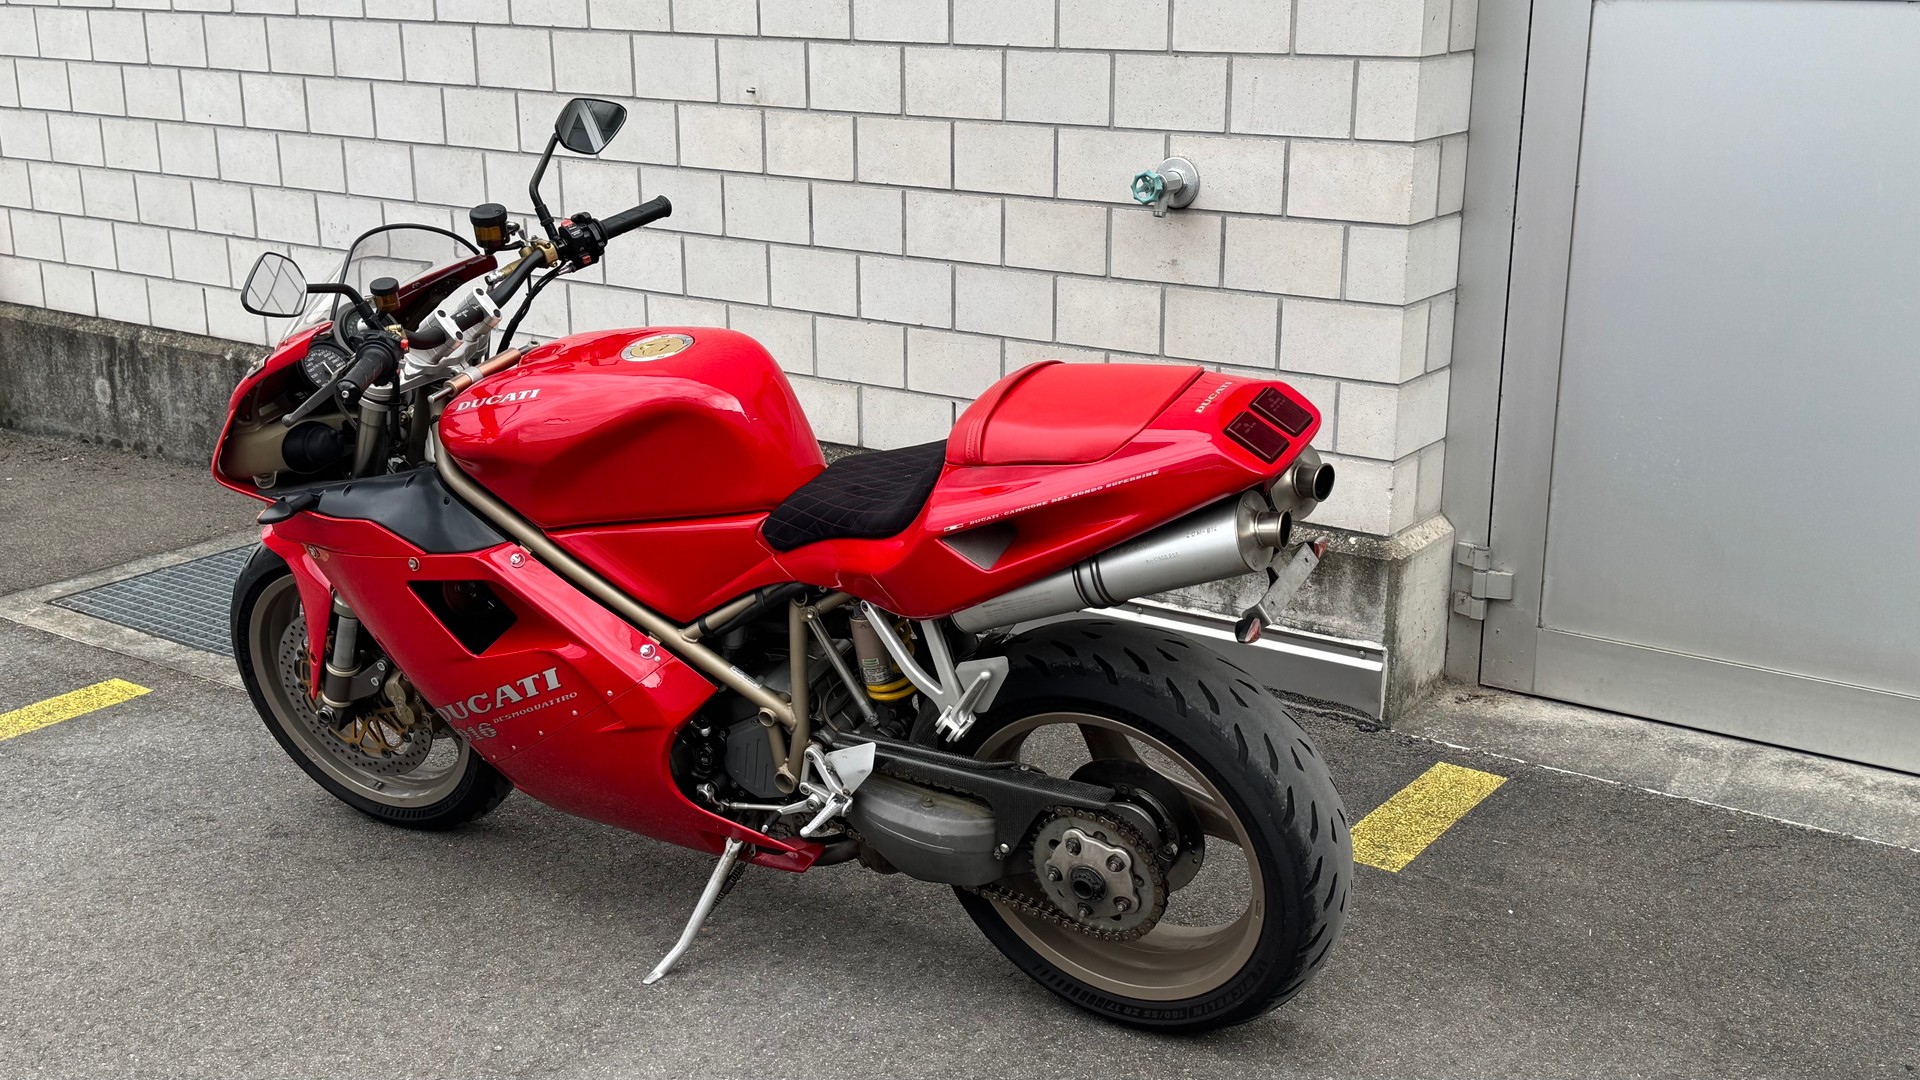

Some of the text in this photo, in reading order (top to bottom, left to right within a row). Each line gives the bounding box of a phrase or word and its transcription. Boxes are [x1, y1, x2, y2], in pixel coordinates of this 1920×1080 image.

[455, 388, 541, 412] DUCATI
[1194, 381, 1234, 414] DUCATI
[969, 469, 1160, 526] DUCATI CAMPIONE DEL MONDO SUPERBIKE
[492, 691, 578, 724] DESMOQUATTRO
[1106, 1001, 1121, 1013] 17
[1123, 1005, 1141, 1017] ZR
[1193, 975, 1255, 1018] MICHELIN
